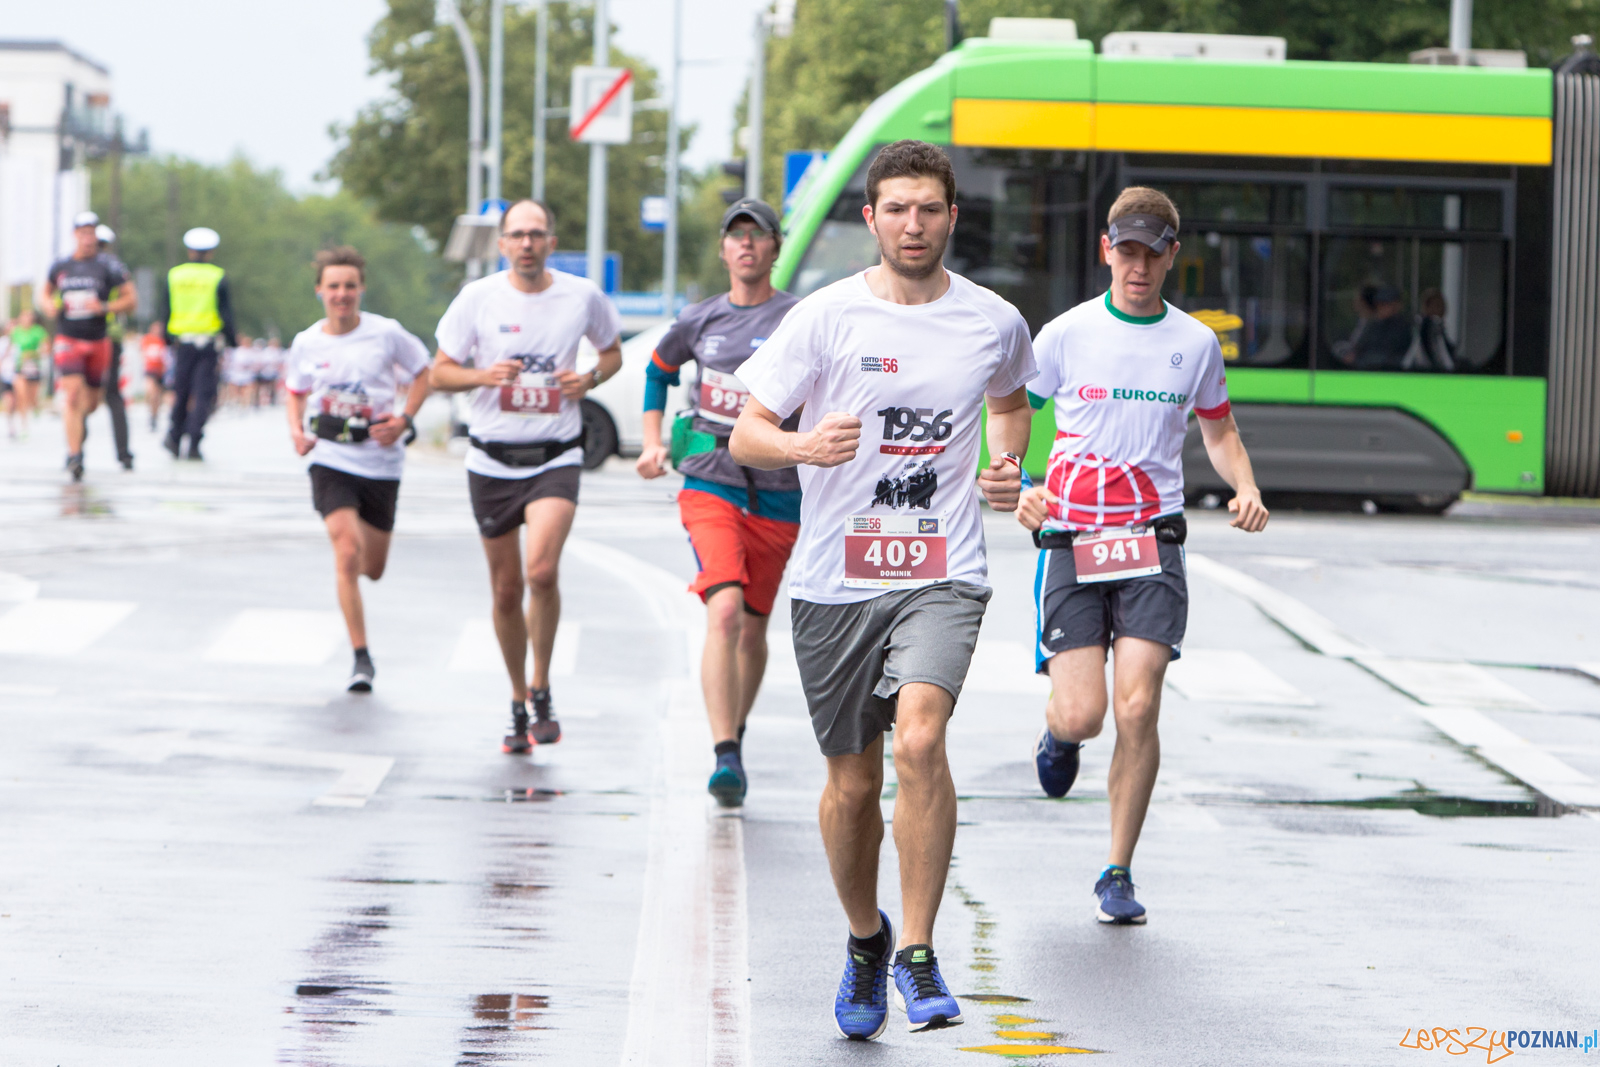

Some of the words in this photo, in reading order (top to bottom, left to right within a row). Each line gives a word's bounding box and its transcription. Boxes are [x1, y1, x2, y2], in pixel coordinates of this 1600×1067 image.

[511, 387, 549, 408] 833
[877, 406, 953, 442] 1956
[864, 540, 928, 567] 409
[1092, 539, 1140, 566] 941
[913, 949, 927, 958] NIKE
